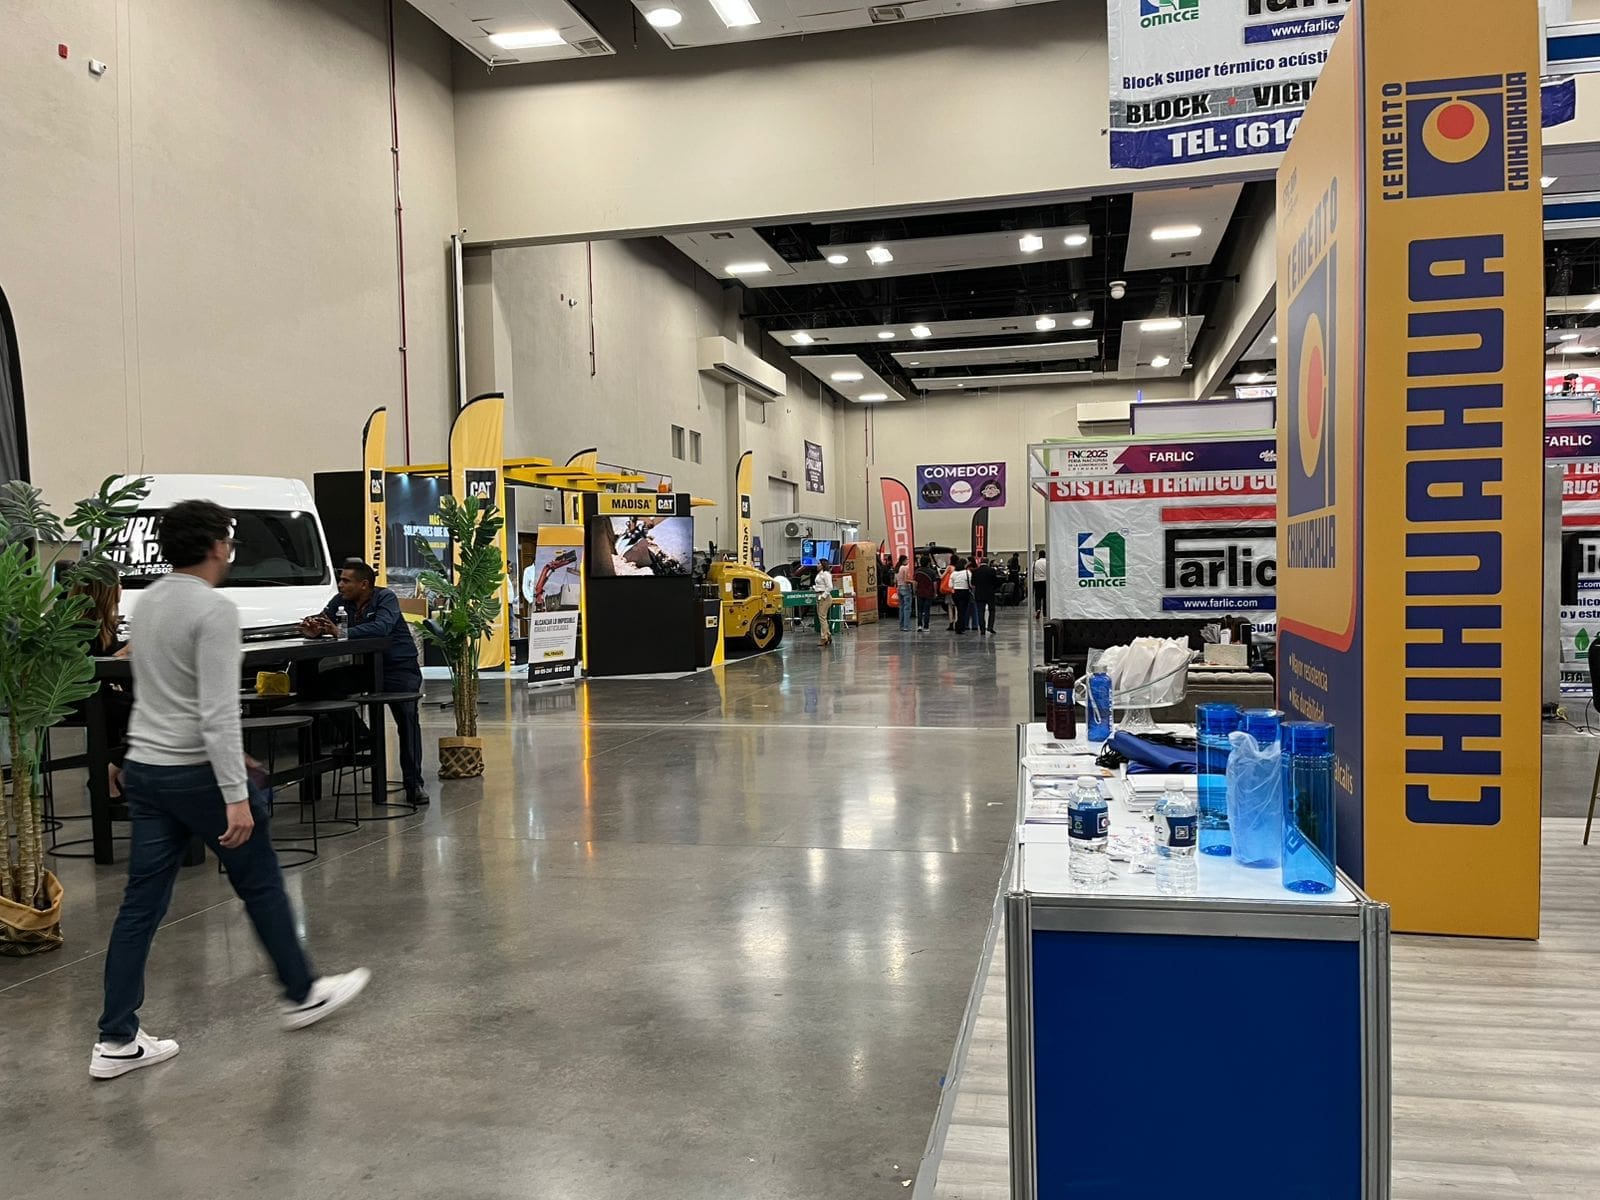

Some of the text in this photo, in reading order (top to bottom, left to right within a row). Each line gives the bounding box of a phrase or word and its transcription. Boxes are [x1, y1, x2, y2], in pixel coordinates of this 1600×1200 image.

[1123, 73, 1163, 89] Block
[1166, 65, 1211, 84] super
[1214, 56, 1275, 76] térmico
[1126, 94, 1211, 125] BLOCK
[1168, 127, 1228, 158] TEL:
[1382, 83, 1404, 200] CEMENTO
[1506, 71, 1529, 191] CHIHUAHUA
[1287, 176, 1338, 299] CEMENTO
[924, 465, 998, 479] COMEDOR
[1149, 451, 1195, 463] FARLIC
[470, 480, 492, 499] CAT
[1056, 479, 1146, 497] SISTEMA
[611, 499, 673, 510] MADISA CAT
[1288, 515, 1336, 568] CHIHUAHUA
[1405, 233, 1505, 826] CHIHUAHUA
[1165, 527, 1276, 589] Farlic
[1183, 598, 1258, 608] www.farlic.com
[1304, 660, 1328, 692] resistencia
